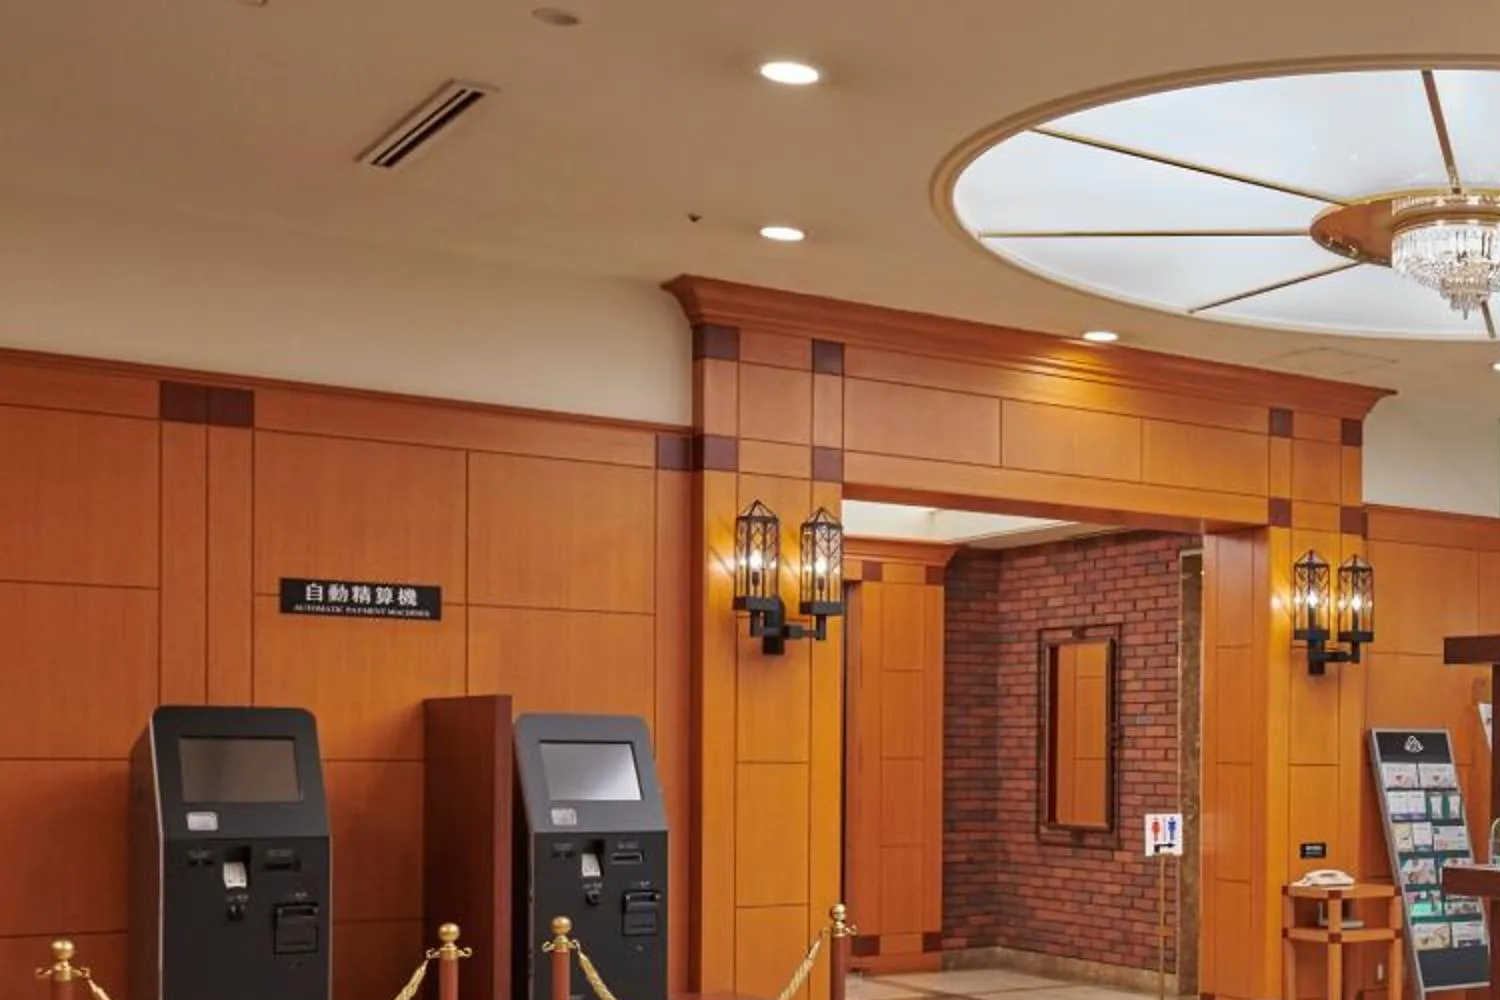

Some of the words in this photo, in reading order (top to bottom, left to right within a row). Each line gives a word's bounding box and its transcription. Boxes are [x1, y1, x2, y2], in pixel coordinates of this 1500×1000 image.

[305, 583, 418, 606] 自動精算機
